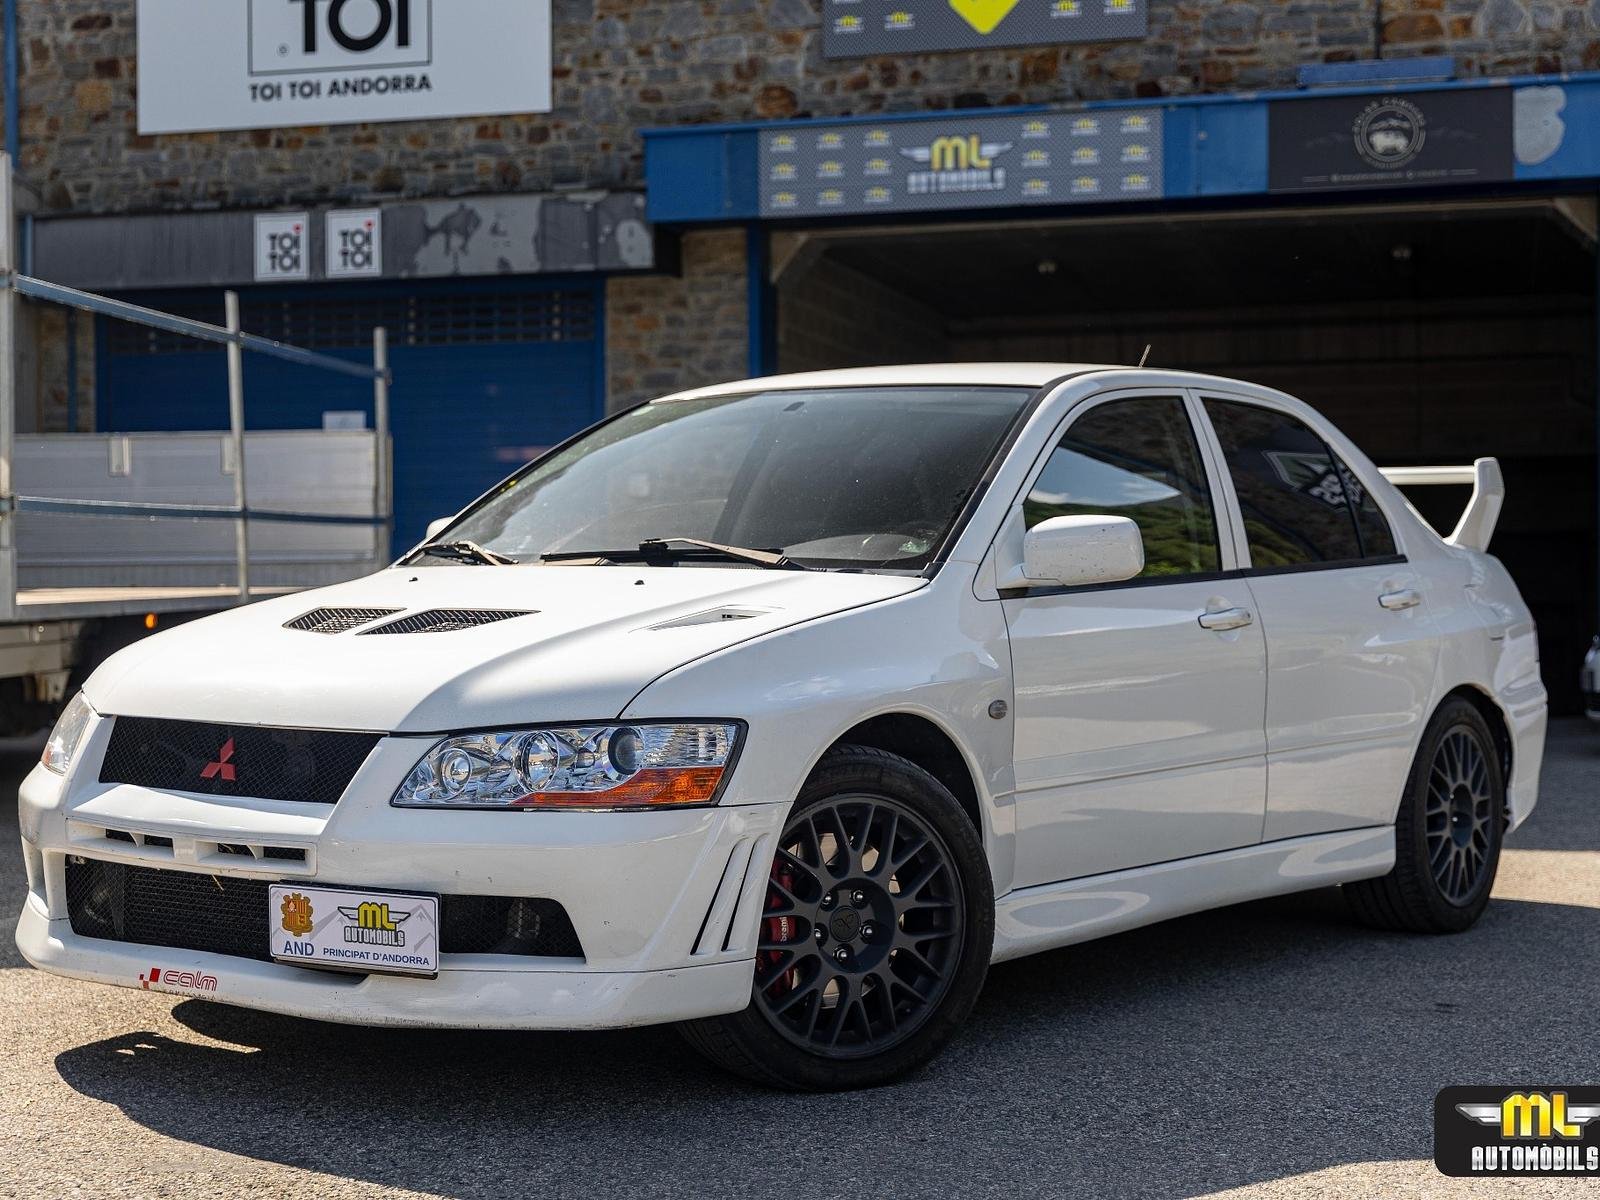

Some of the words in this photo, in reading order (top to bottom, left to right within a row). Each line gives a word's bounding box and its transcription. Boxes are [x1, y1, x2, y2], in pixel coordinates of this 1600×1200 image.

[288, 0, 411, 52] TOI
[250, 80, 282, 102] TOI
[288, 78, 321, 99] TOI
[328, 73, 432, 98] ANDORRA
[268, 251, 301, 271] TOI
[338, 249, 373, 268] TOI
[357, 901, 397, 931] ML
[283, 940, 314, 956] AND
[323, 947, 371, 961] PRINCIPAT
[373, 952, 430, 966] D'ANDORRA
